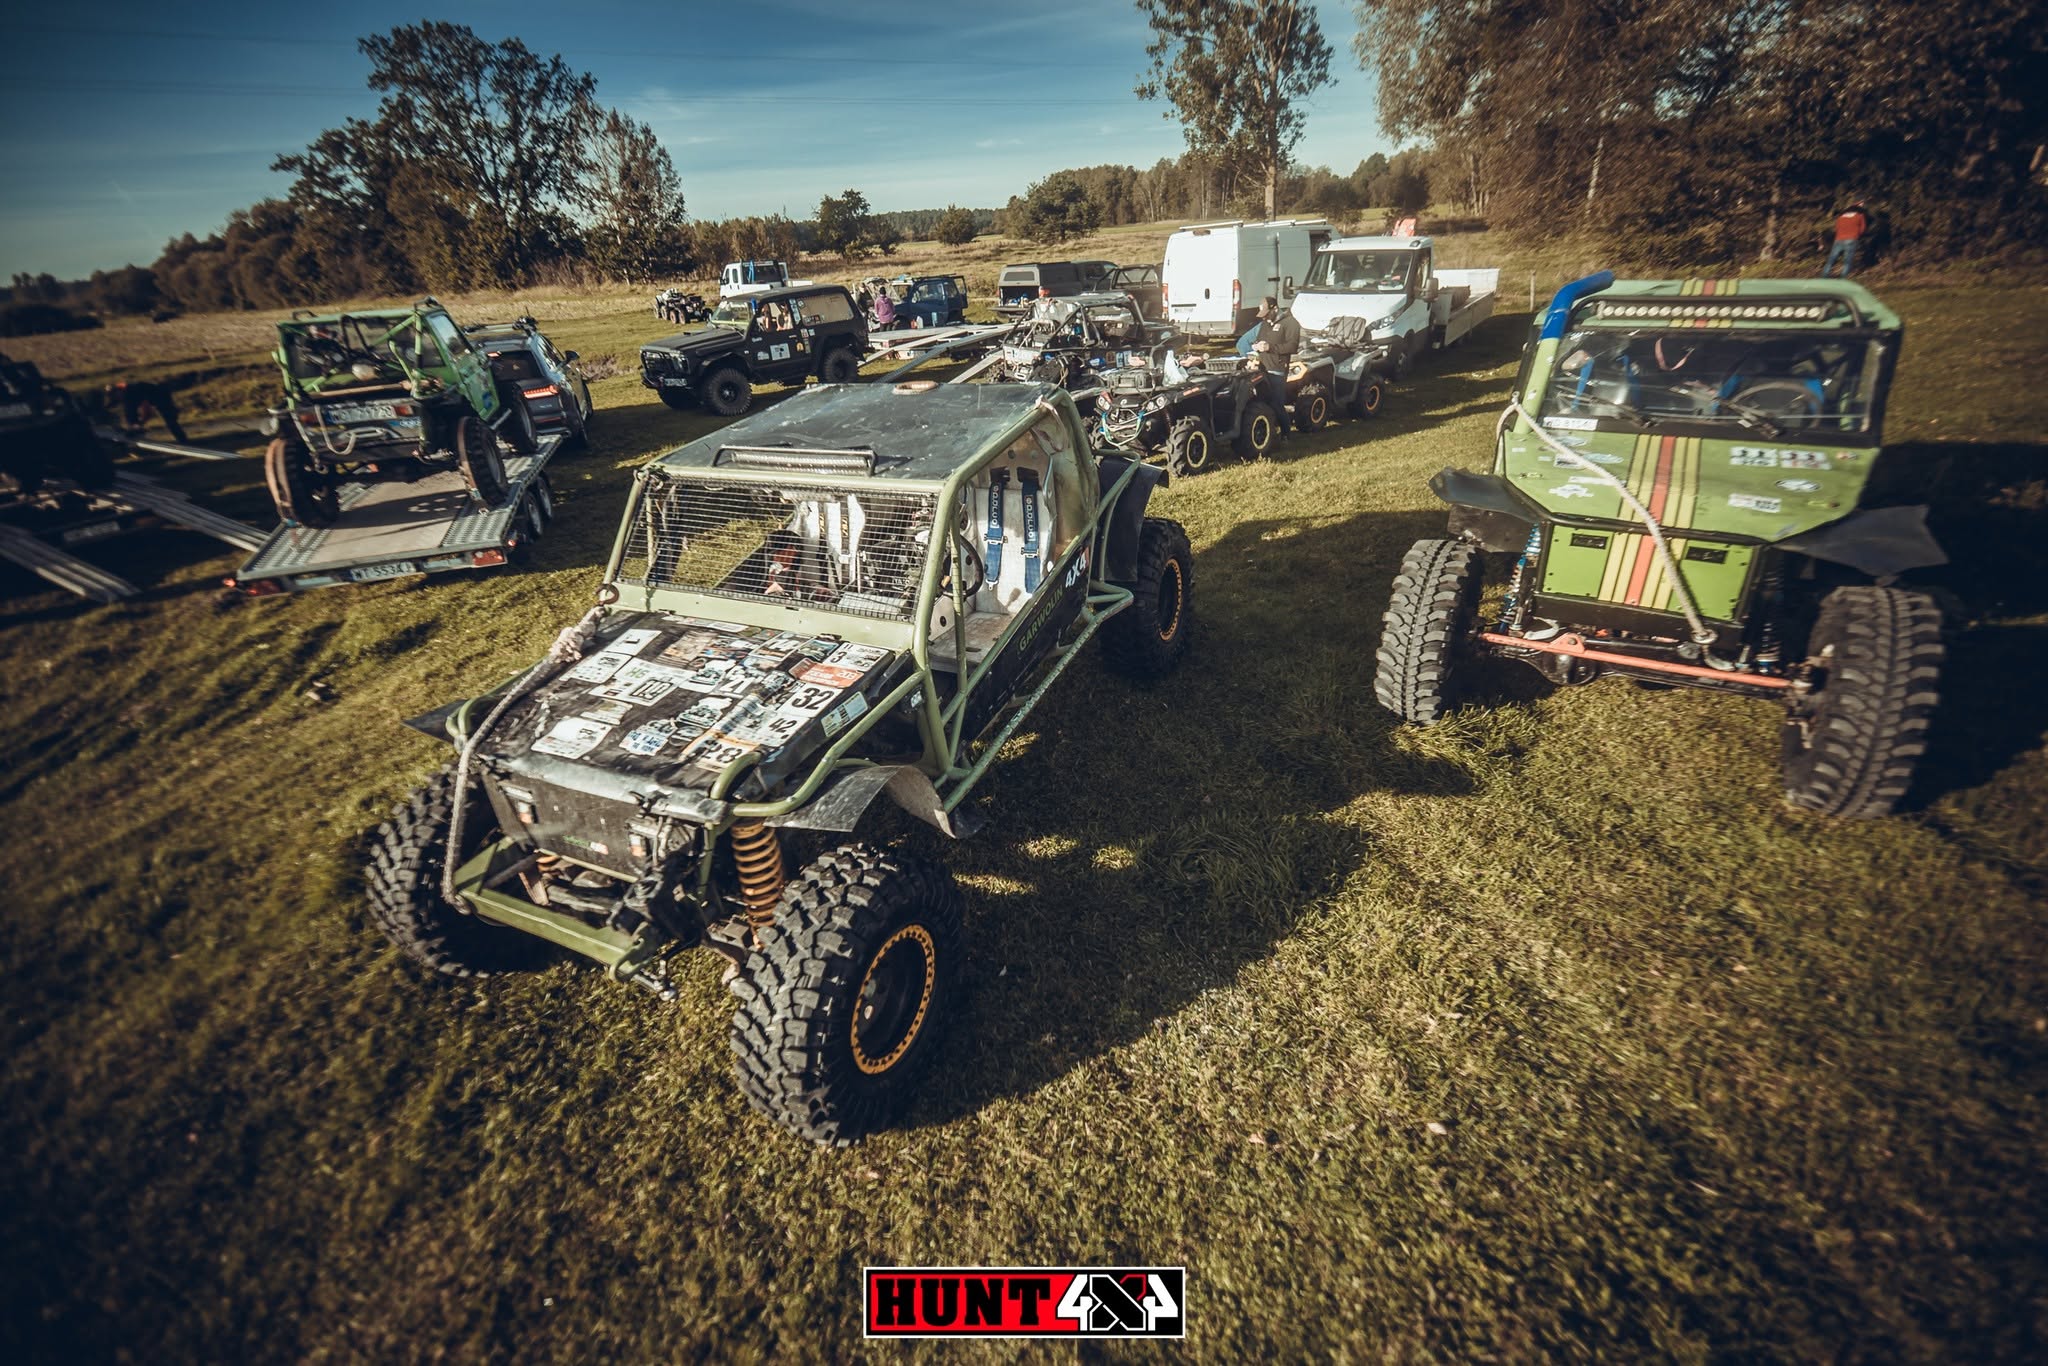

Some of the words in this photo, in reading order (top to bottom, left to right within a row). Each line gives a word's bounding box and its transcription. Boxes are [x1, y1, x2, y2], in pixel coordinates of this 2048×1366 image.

[1019, 586, 1064, 651] GARWOLIN
[791, 687, 835, 711] 32
[769, 717, 798, 734] 42
